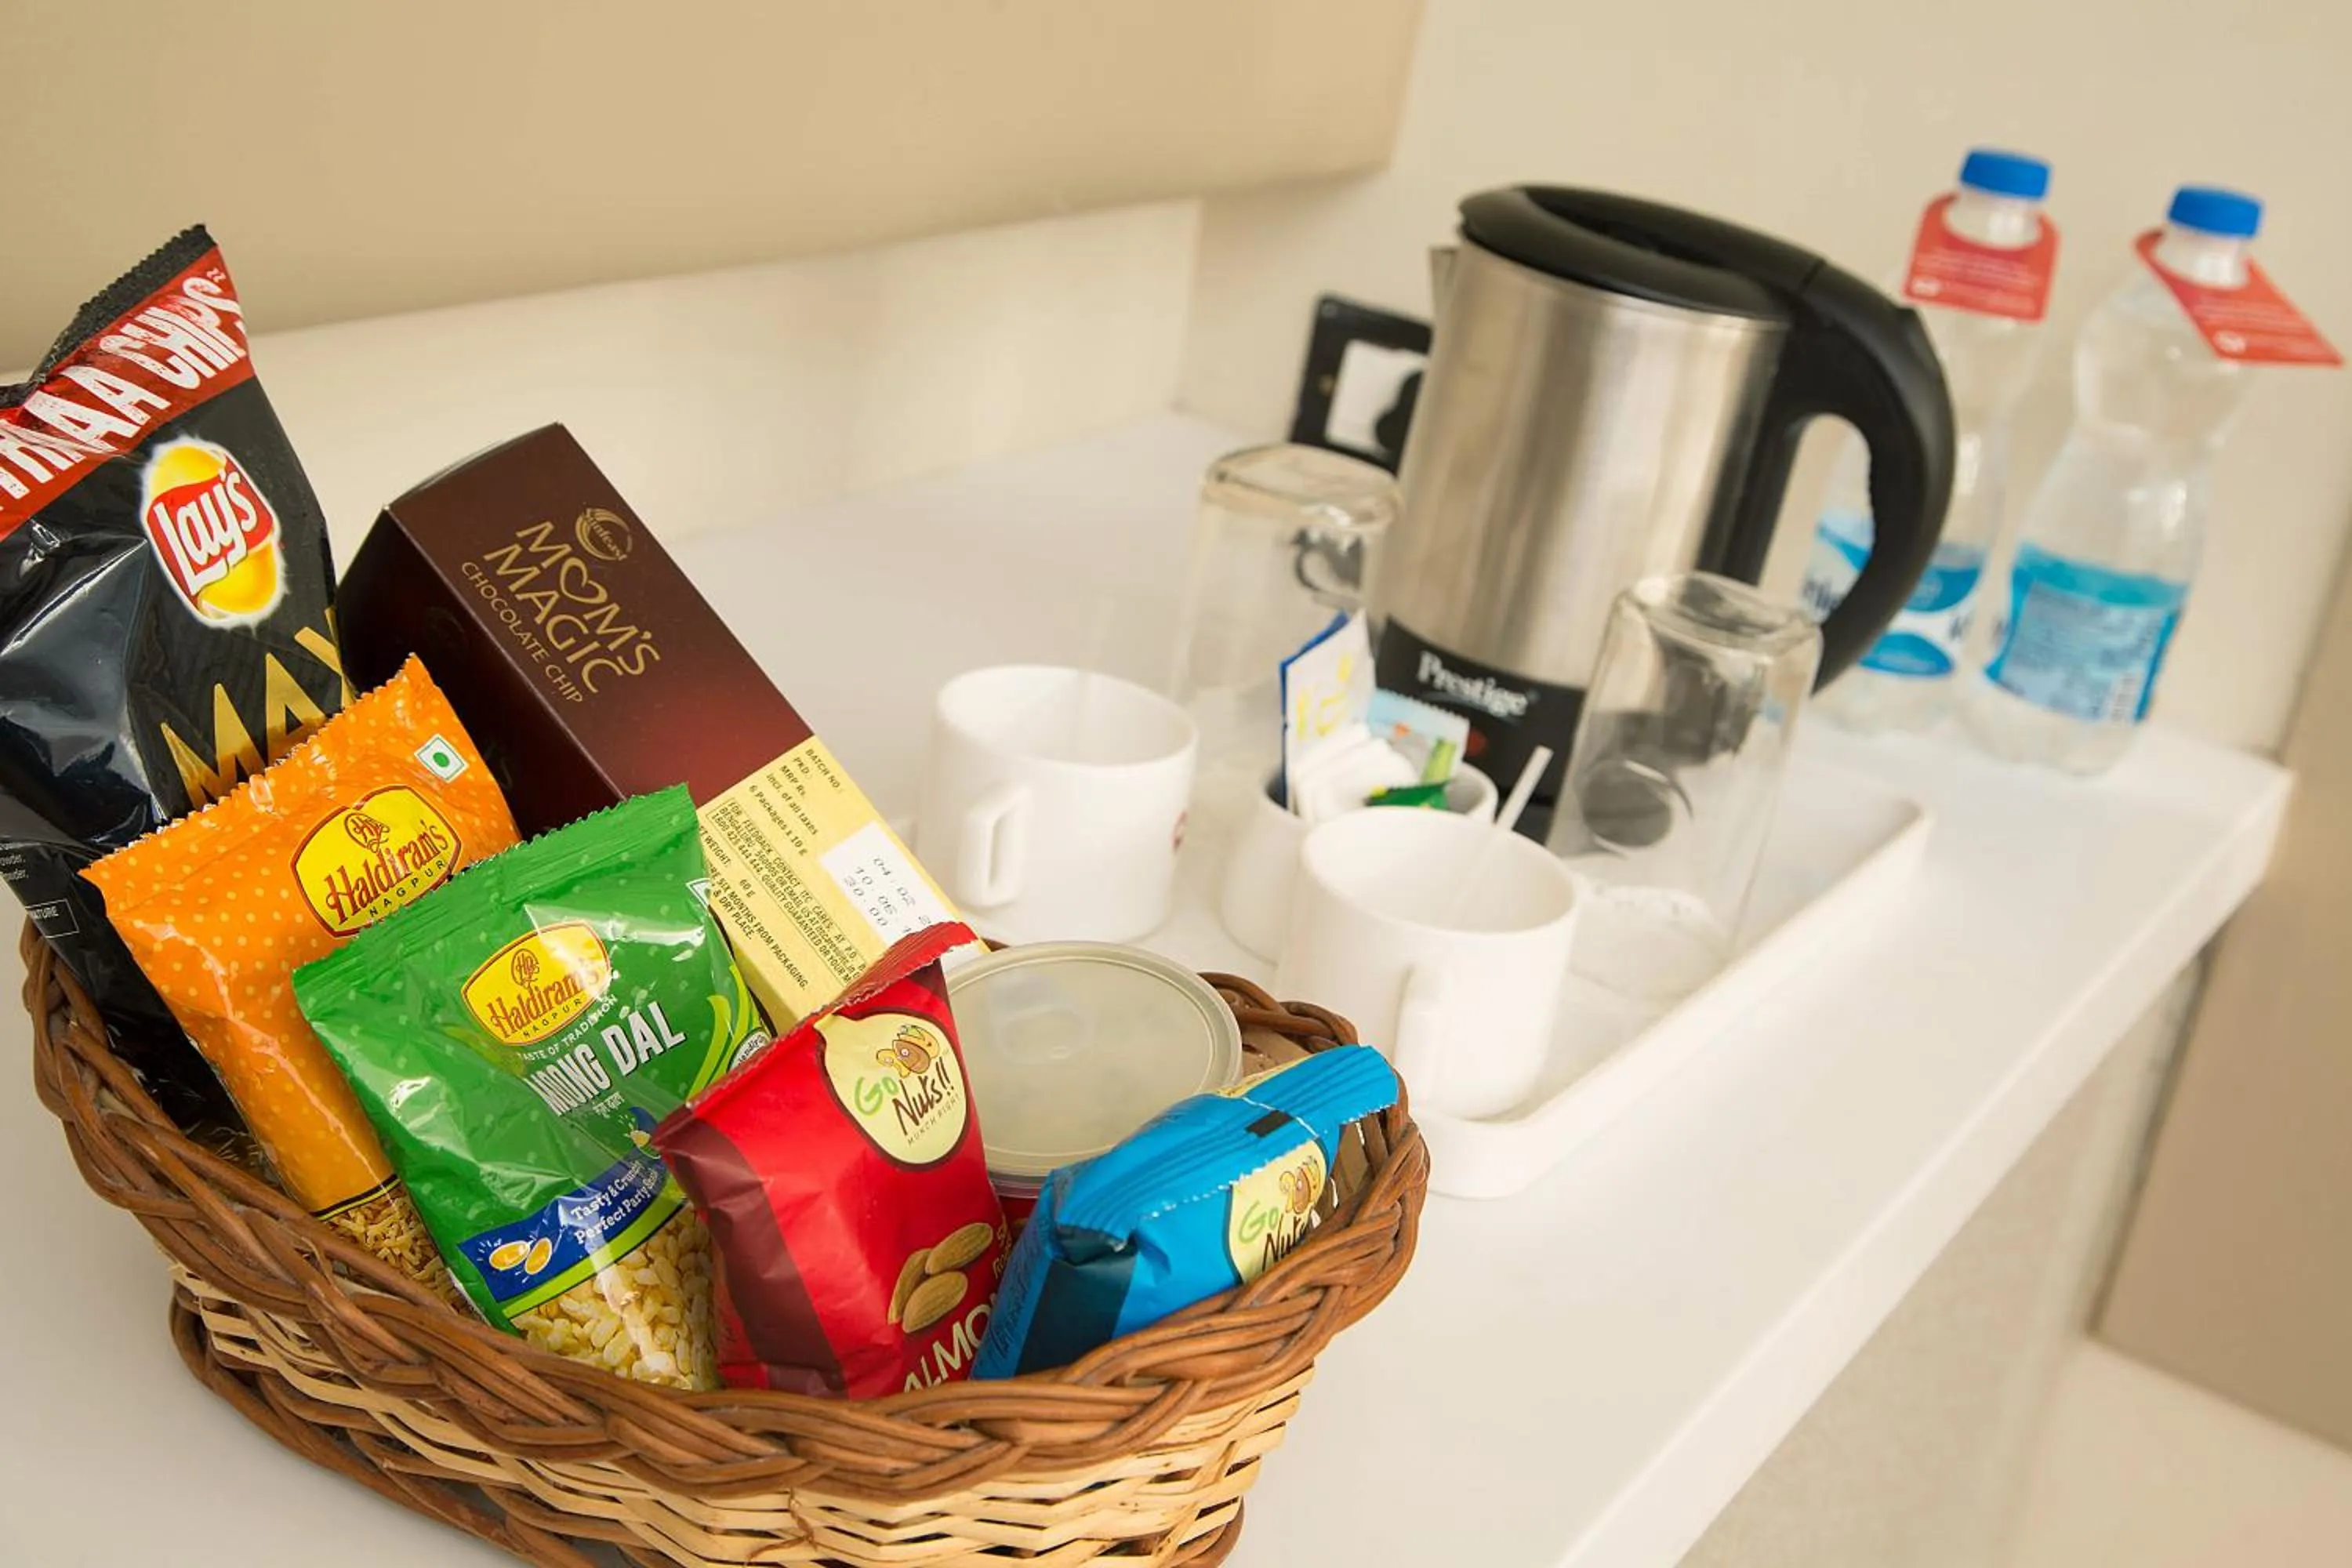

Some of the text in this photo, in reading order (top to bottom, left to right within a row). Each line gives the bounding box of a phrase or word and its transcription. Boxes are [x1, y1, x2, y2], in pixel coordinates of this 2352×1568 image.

[100, 276, 247, 390] CHIPS
[154, 466, 258, 597] Lay's
[462, 561, 583, 703] CHOCOLATE CHIP
[484, 543, 623, 693] MAGIC
[1417, 650, 1529, 718] Prestige
[780, 765, 797, 785] MRP
[805, 748, 829, 776] BATCH
[754, 791, 787, 830] Packages
[791, 837, 802, 848] 10
[781, 791, 791, 801] of
[789, 801, 800, 812] all
[799, 813, 817, 834] taxes
[324, 819, 448, 926] Haldiram's
[369, 859, 445, 918] NAGPUR
[728, 801, 742, 816] FOR
[742, 818, 773, 855] FEEDBACK
[772, 856, 799, 887] CONTACT
[800, 890, 811, 902] ITC
[834, 933, 844, 944] AT
[775, 875, 786, 887] OR
[784, 885, 803, 906] EMAIL
[800, 906, 811, 917] US
[809, 916, 818, 925] AT
[717, 877, 809, 989] SIX MONTHS FROM PACKAGING.
[719, 896, 734, 913] DRY
[731, 912, 754, 938] PLACE.
[738, 844, 752, 858] 444
[760, 873, 786, 903] QUALITY
[784, 900, 822, 946] GUARANTEED
[819, 945, 830, 956] OR
[827, 955, 845, 975] YOUR
[523, 997, 583, 1039] NAGPUR
[548, 1041, 560, 1057] OF
[601, 1001, 686, 1076] DAL
[855, 1057, 955, 1137] Go Nuts!!
[573, 1191, 612, 1221] Tasty
[574, 1207, 626, 1245] Perfect
[622, 1185, 652, 1213] Party
[1238, 1200, 1308, 1273] Go Nut
[904, 1293, 998, 1393] ALMO
